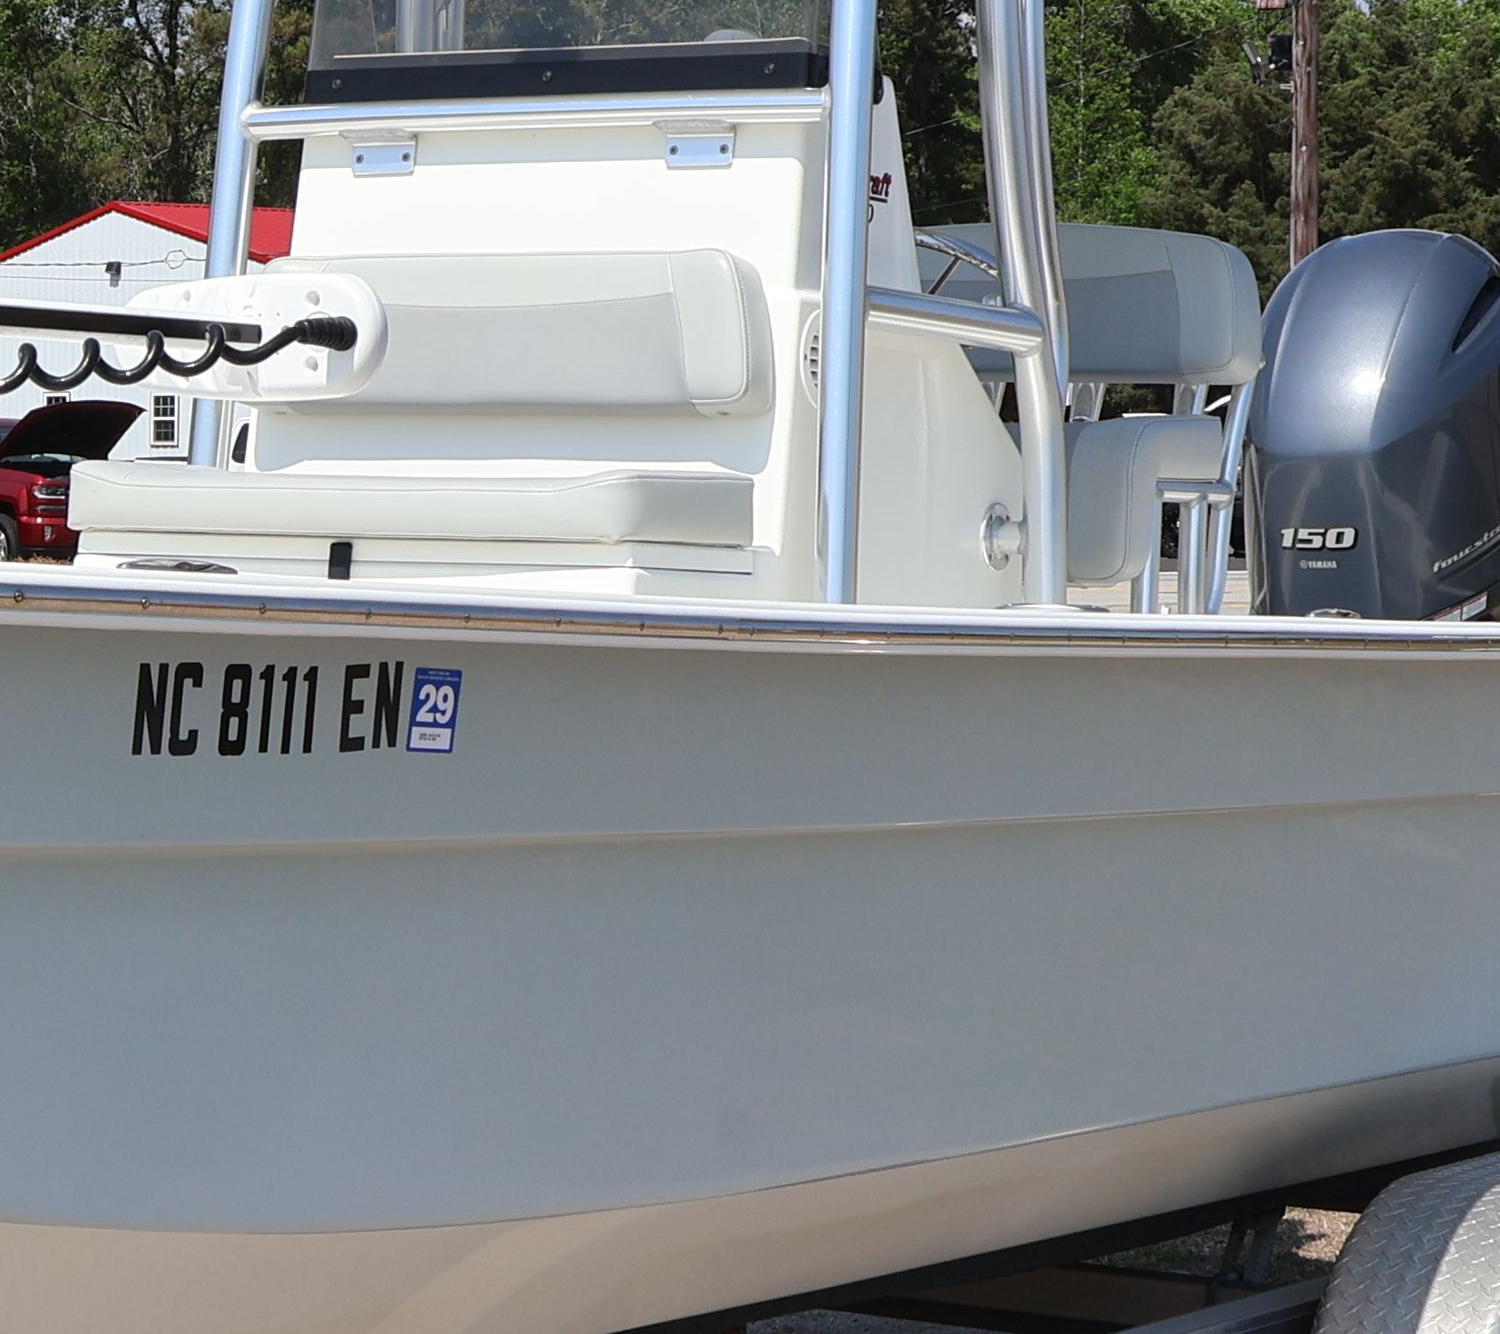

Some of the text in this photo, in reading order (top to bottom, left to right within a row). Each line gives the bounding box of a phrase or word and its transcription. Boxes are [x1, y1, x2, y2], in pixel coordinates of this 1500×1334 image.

[1281, 527, 1357, 550] 150
[1307, 560, 1338, 569] YAMAHA
[131, 661, 404, 756] NC 8111 EN
[415, 683, 455, 724] 29
